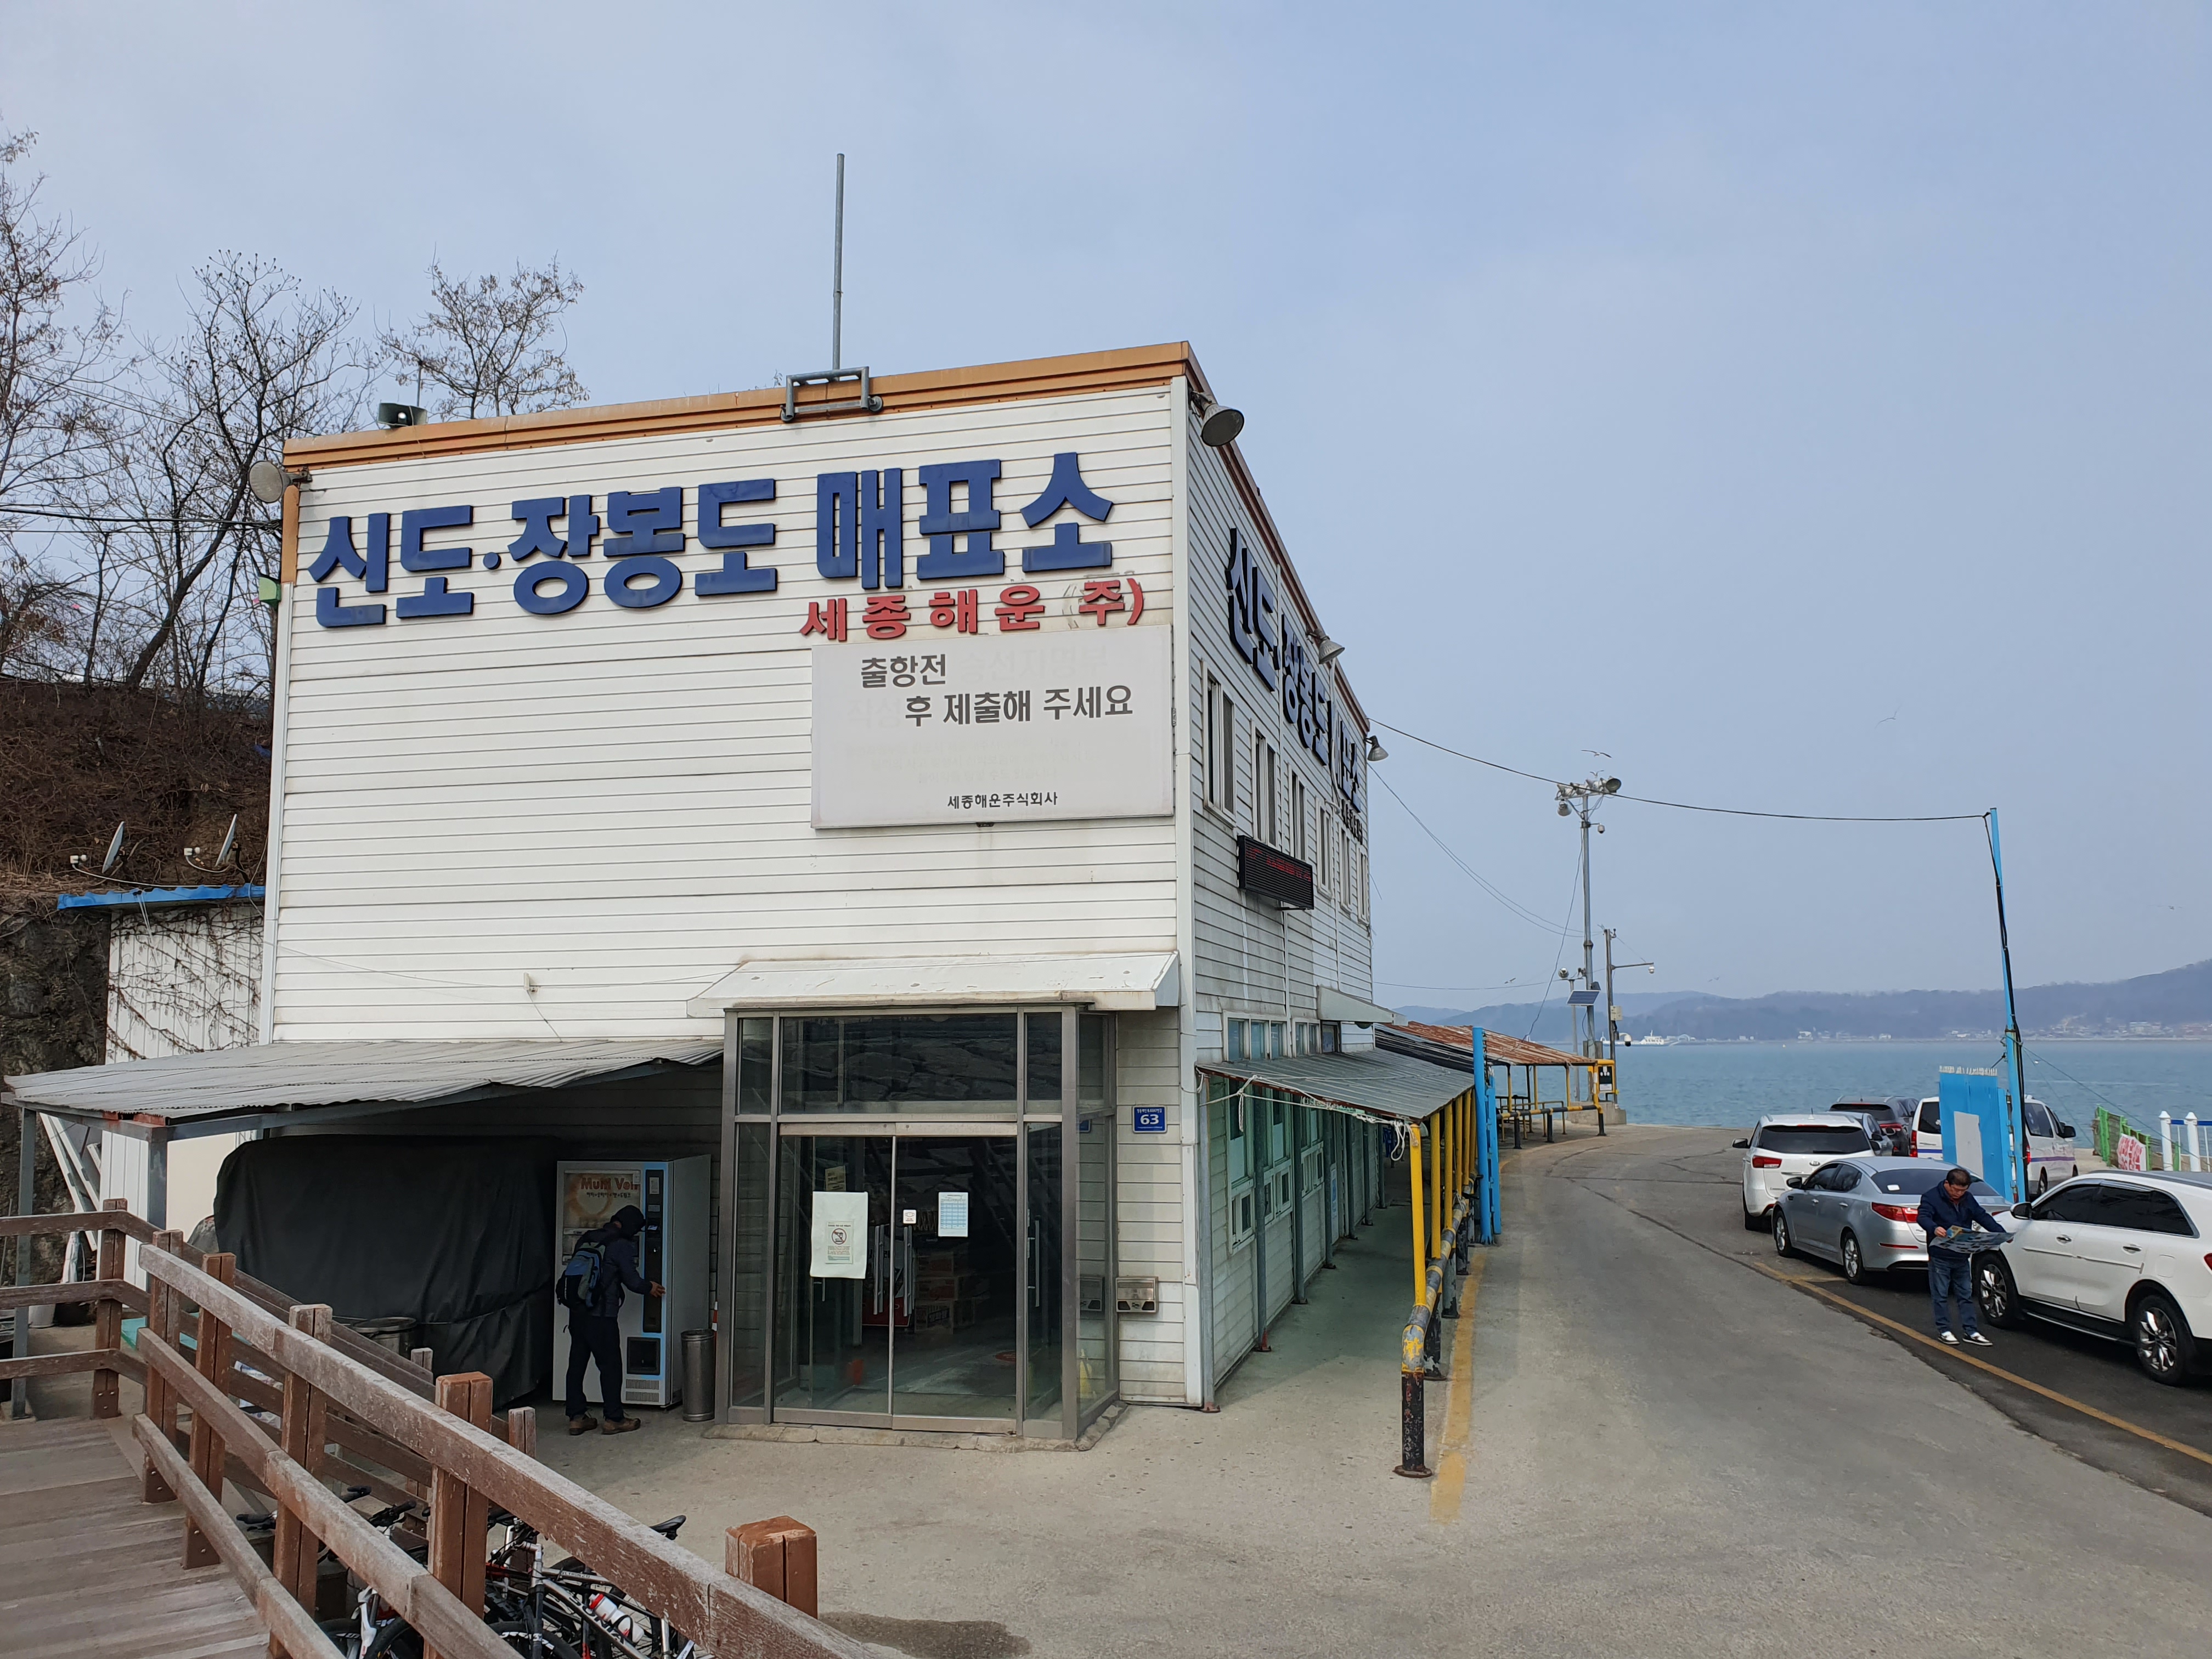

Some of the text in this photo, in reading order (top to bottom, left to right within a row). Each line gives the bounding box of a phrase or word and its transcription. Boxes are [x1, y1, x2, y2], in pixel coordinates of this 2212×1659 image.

[816, 452, 1114, 590] 매표소
[861, 654, 946, 689] 출항전
[905, 695, 932, 726] 후
[943, 690, 1031, 725] 제출해
[1043, 685, 1132, 720] 주세요
[947, 792, 1058, 809] 세종해운주식회사
[1141, 1114, 1159, 1125] 63
